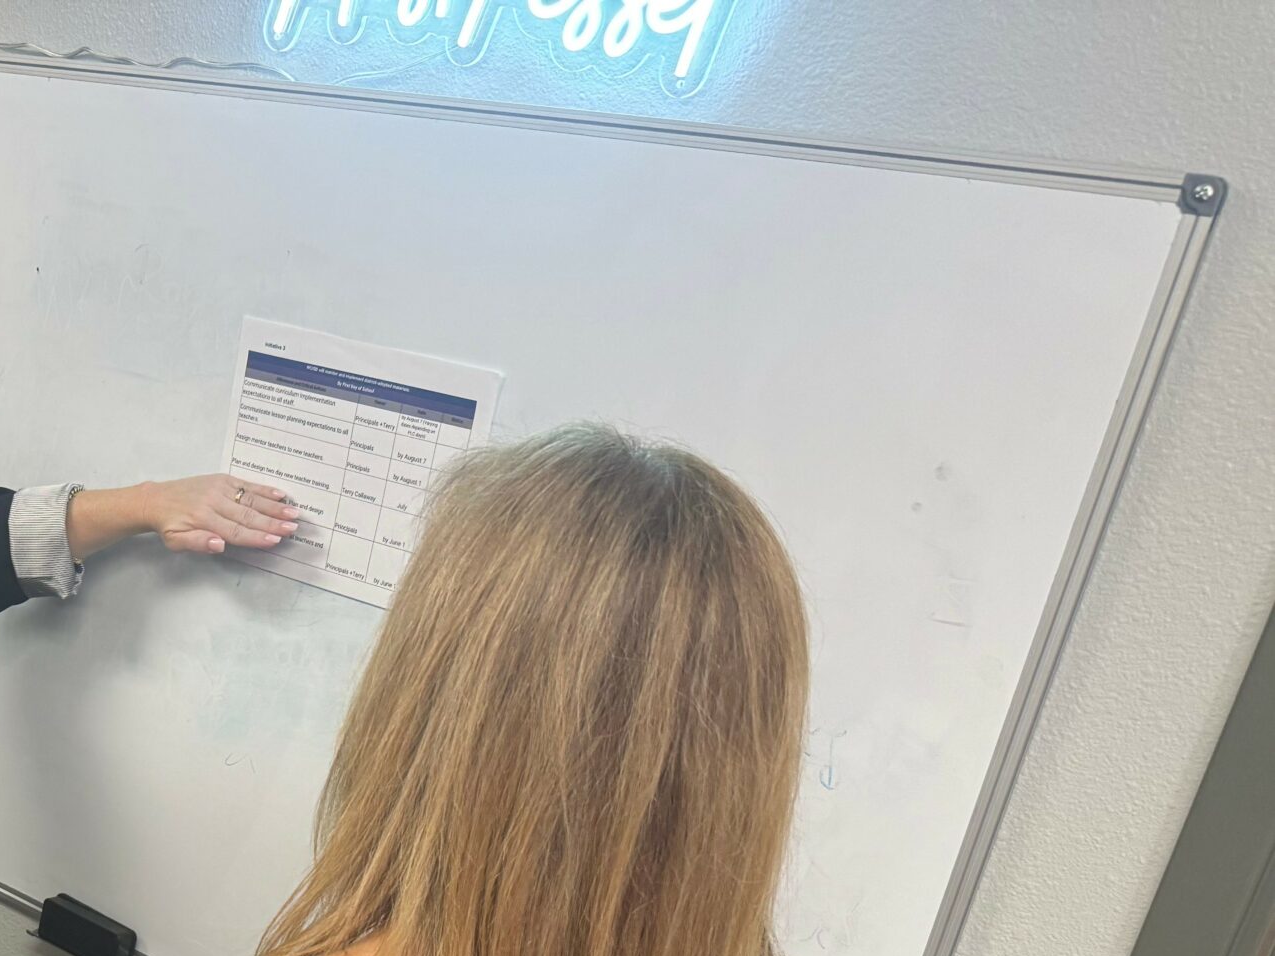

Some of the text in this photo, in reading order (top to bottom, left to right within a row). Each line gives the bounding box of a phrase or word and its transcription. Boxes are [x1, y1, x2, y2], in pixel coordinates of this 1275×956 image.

[242, 389, 270, 401] expectations
[244, 380, 275, 392] Communicate
[275, 387, 300, 398] curriculum
[300, 391, 336, 407] implementation
[240, 403, 271, 416] Communicate
[271, 410, 285, 420] lesson
[286, 415, 306, 426] planning
[307, 420, 336, 433] expectations
[336, 426, 342, 434] to
[355, 415, 378, 427] Principals
[236, 433, 251, 443] Assign
[251, 437, 266, 446] mentor
[267, 440, 286, 452] teachers
[350, 440, 374, 451] Principals
[397, 452, 403, 460] by
[404, 454, 422, 464] August
[232, 457, 242, 465] Plan
[242, 460, 250, 468] and
[250, 463, 266, 473] design
[275, 469, 283, 477] day
[294, 475, 311, 484] teacher
[346, 462, 370, 473] Principals
[393, 474, 399, 482] by
[400, 476, 417, 486] August
[342, 487, 376, 503] Terry Callaway
[299, 503, 308, 511] and
[309, 506, 324, 515] design
[397, 503, 408, 511] July
[334, 522, 358, 534] Principals
[382, 536, 388, 544] by
[389, 539, 401, 547] June
[326, 562, 349, 574] Principals
[373, 577, 379, 585] by
